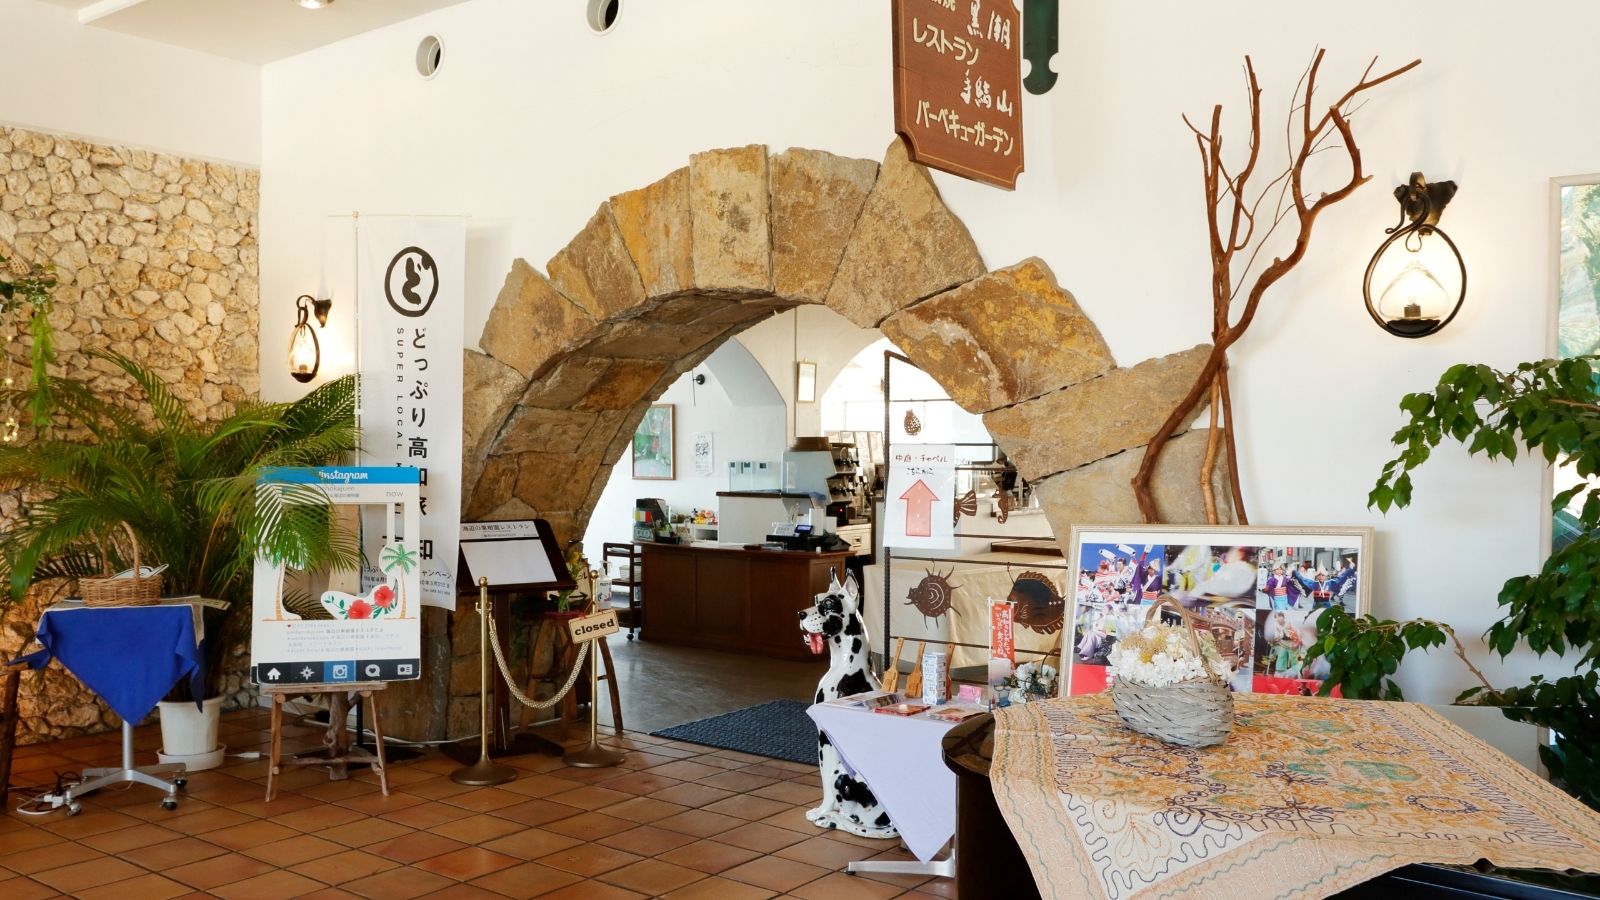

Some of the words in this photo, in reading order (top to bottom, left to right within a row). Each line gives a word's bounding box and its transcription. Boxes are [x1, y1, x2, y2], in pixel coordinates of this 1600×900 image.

[913, 18, 979, 65] レストラン
[916, 100, 1014, 156] バーベキューガーデン
[396, 327, 405, 383] SUPER
[396, 395, 404, 451] LOCAL
[574, 618, 615, 636] closed
